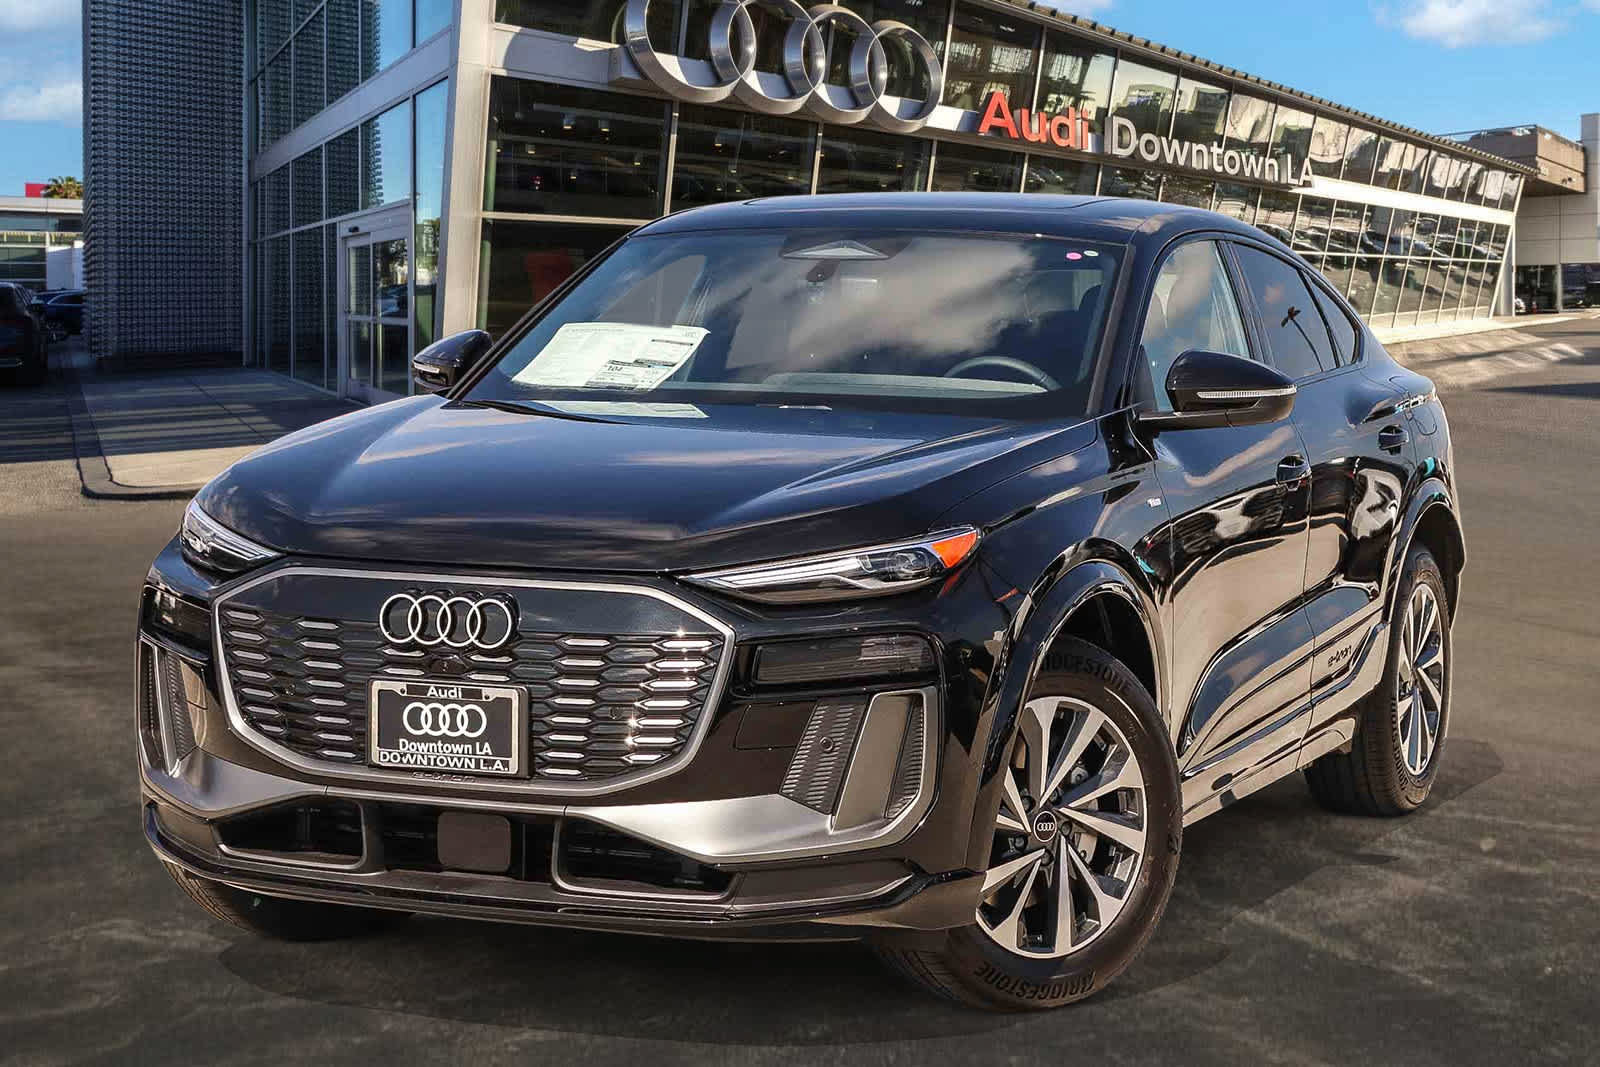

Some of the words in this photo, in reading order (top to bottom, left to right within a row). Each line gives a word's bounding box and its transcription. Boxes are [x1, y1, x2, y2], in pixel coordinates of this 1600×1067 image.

[979, 91, 1089, 151] Audi
[1105, 115, 1279, 183] Downtown
[1287, 153, 1315, 188] LA
[426, 686, 462, 699] Audi
[400, 738, 473, 755] Downtown
[475, 742, 493, 756] LA
[379, 751, 476, 769] DOWNTOWN
[479, 759, 510, 772] L.A.
